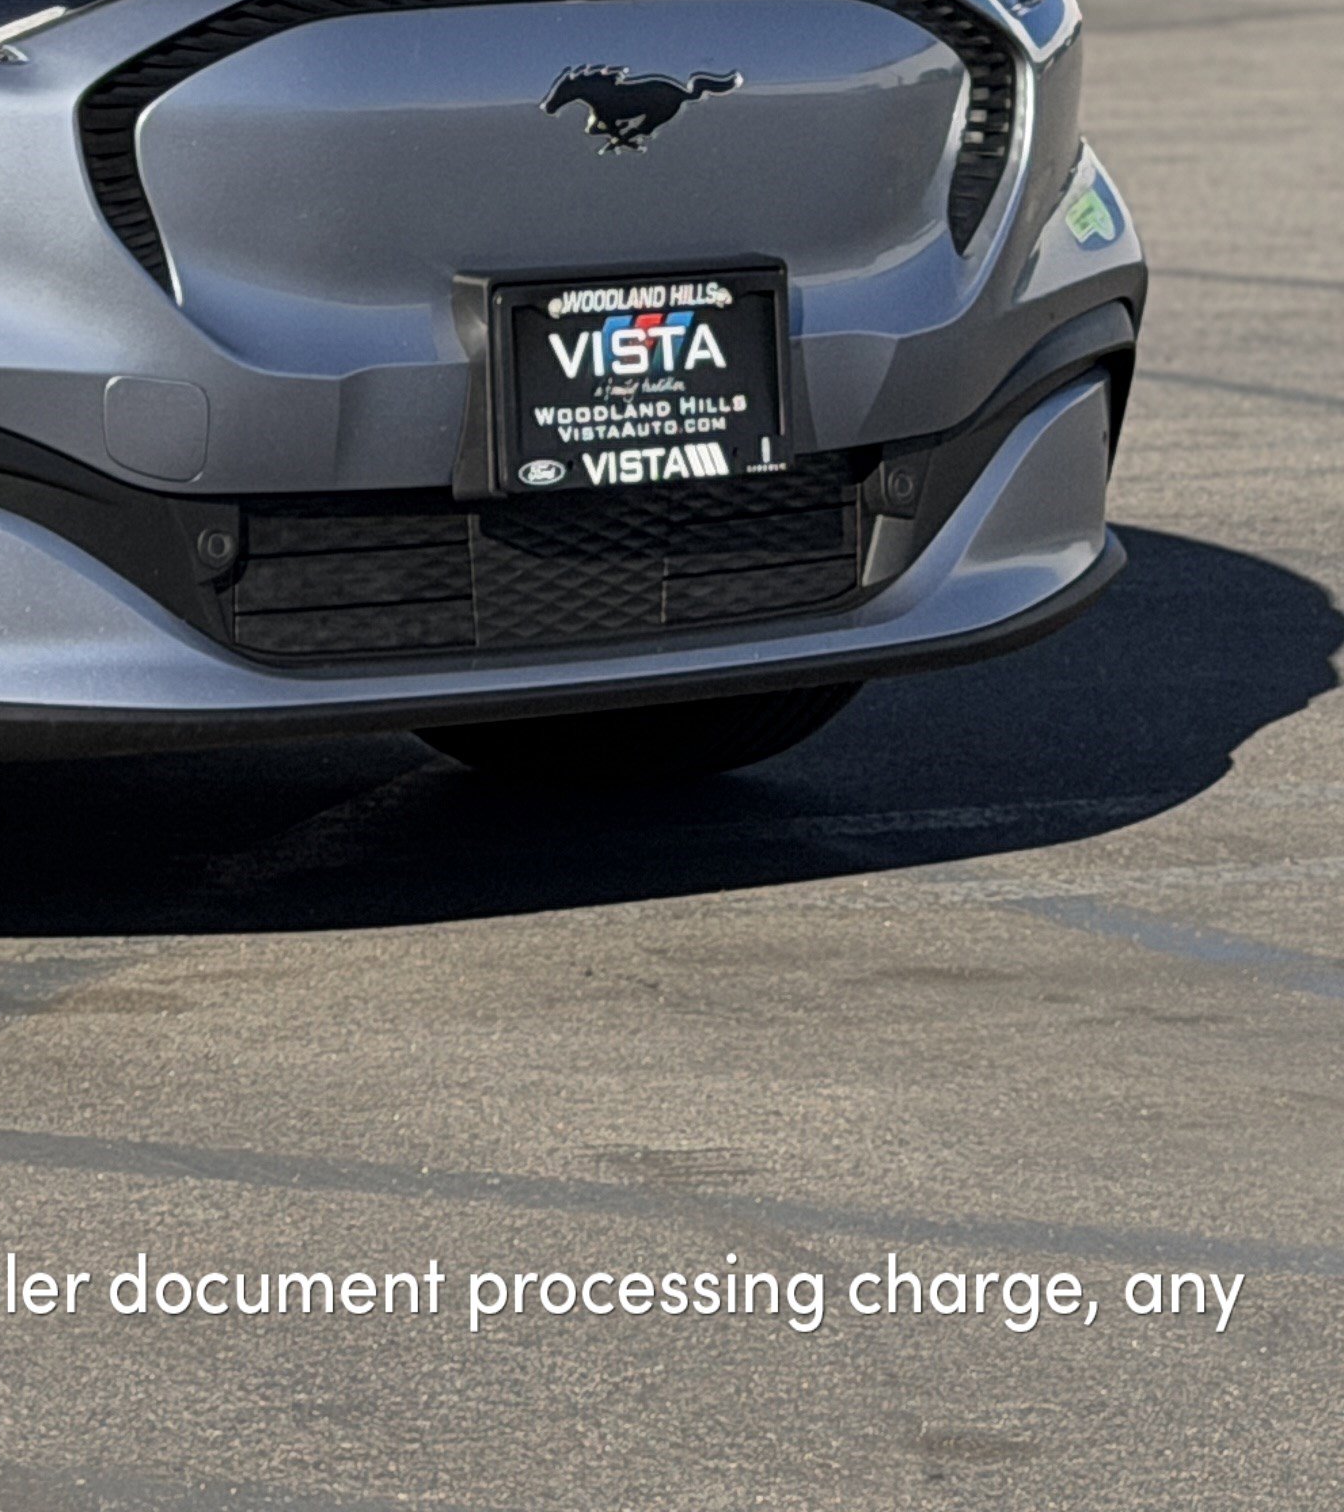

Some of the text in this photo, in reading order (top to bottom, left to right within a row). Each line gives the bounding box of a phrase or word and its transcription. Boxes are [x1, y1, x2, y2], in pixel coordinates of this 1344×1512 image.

[561, 282, 719, 314] WOODLAND HILLS
[548, 323, 727, 380] VISTA
[582, 447, 691, 486] VISTA
